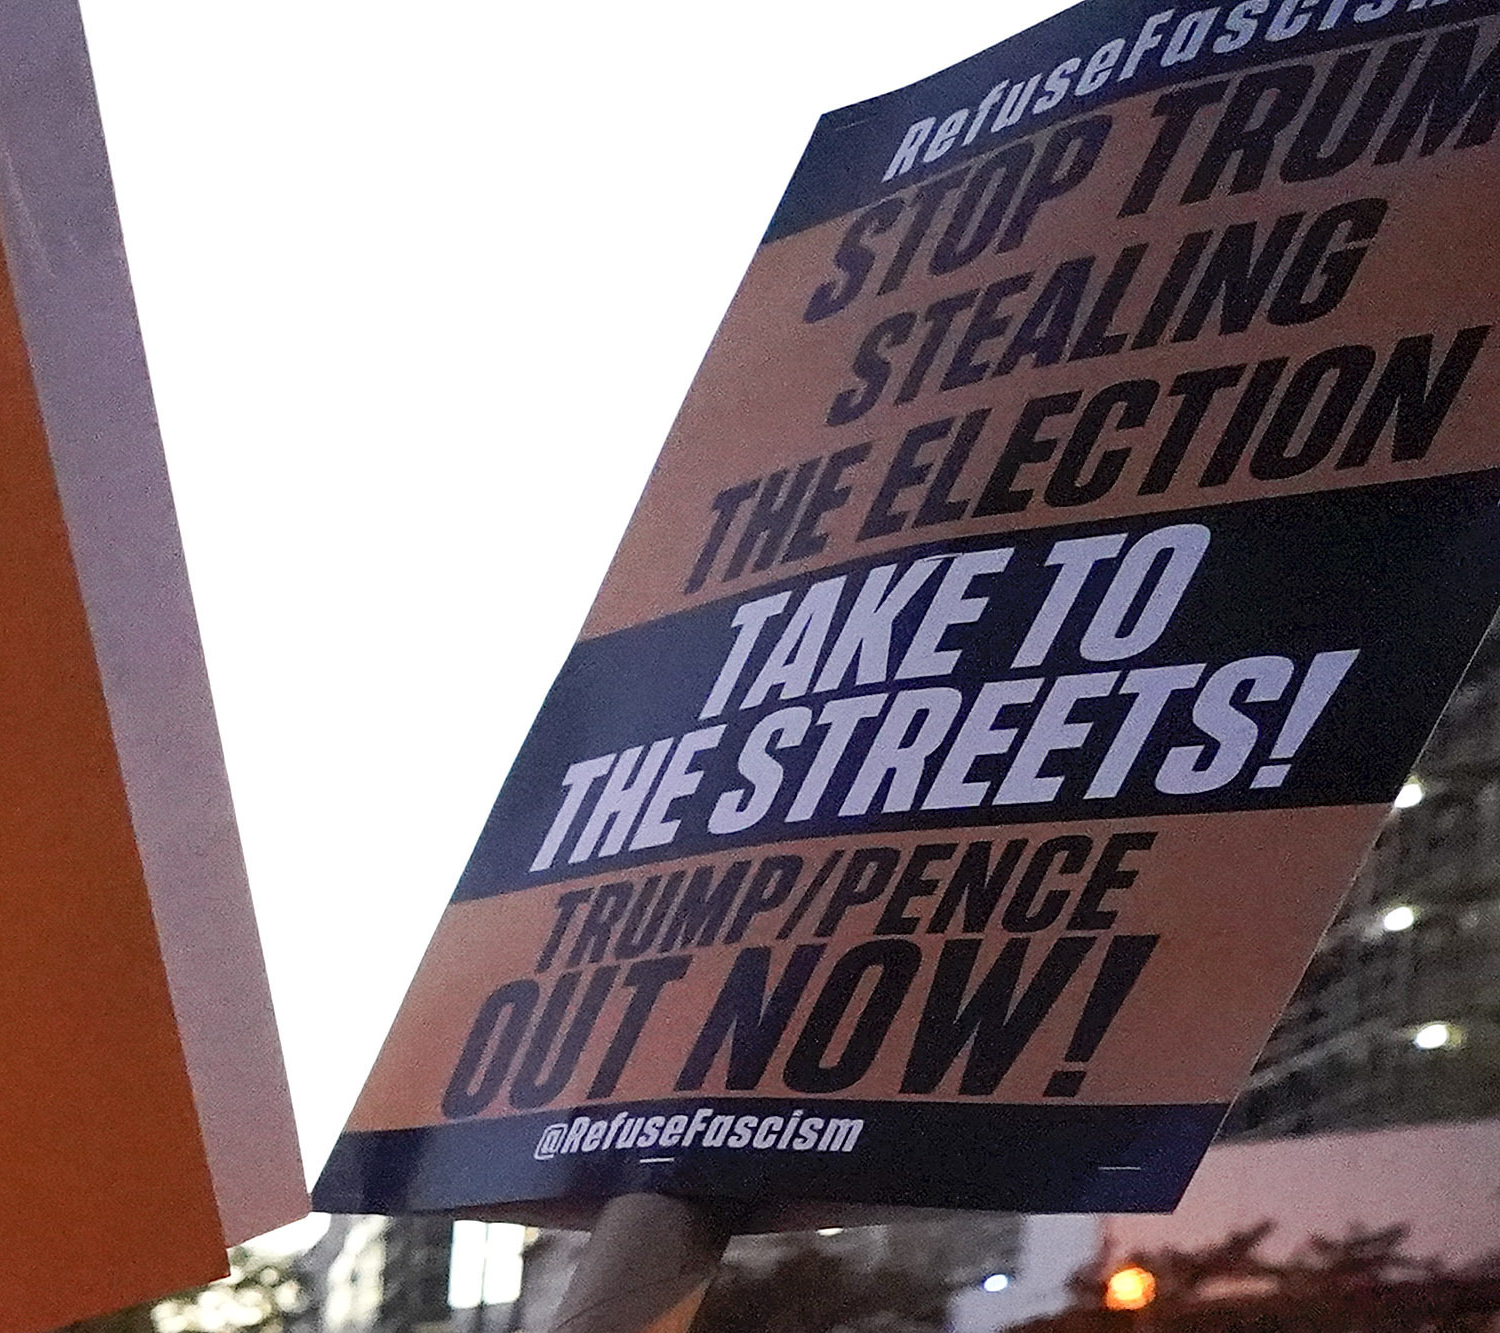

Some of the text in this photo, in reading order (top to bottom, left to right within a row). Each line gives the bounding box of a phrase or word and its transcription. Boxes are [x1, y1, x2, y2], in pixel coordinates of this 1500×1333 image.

[803, 112, 1113, 325] STOP
[826, 197, 1389, 428] STEALING
[684, 324, 1493, 594] THE ELECTION
[699, 523, 1213, 720] TAKE TO
[530, 647, 1360, 873] THE STREETS!
[536, 831, 1159, 976] TRUMP/PENCE
[440, 934, 1160, 1121] OUT NOW!
[533, 1109, 865, 1162] @RefuseFascism
